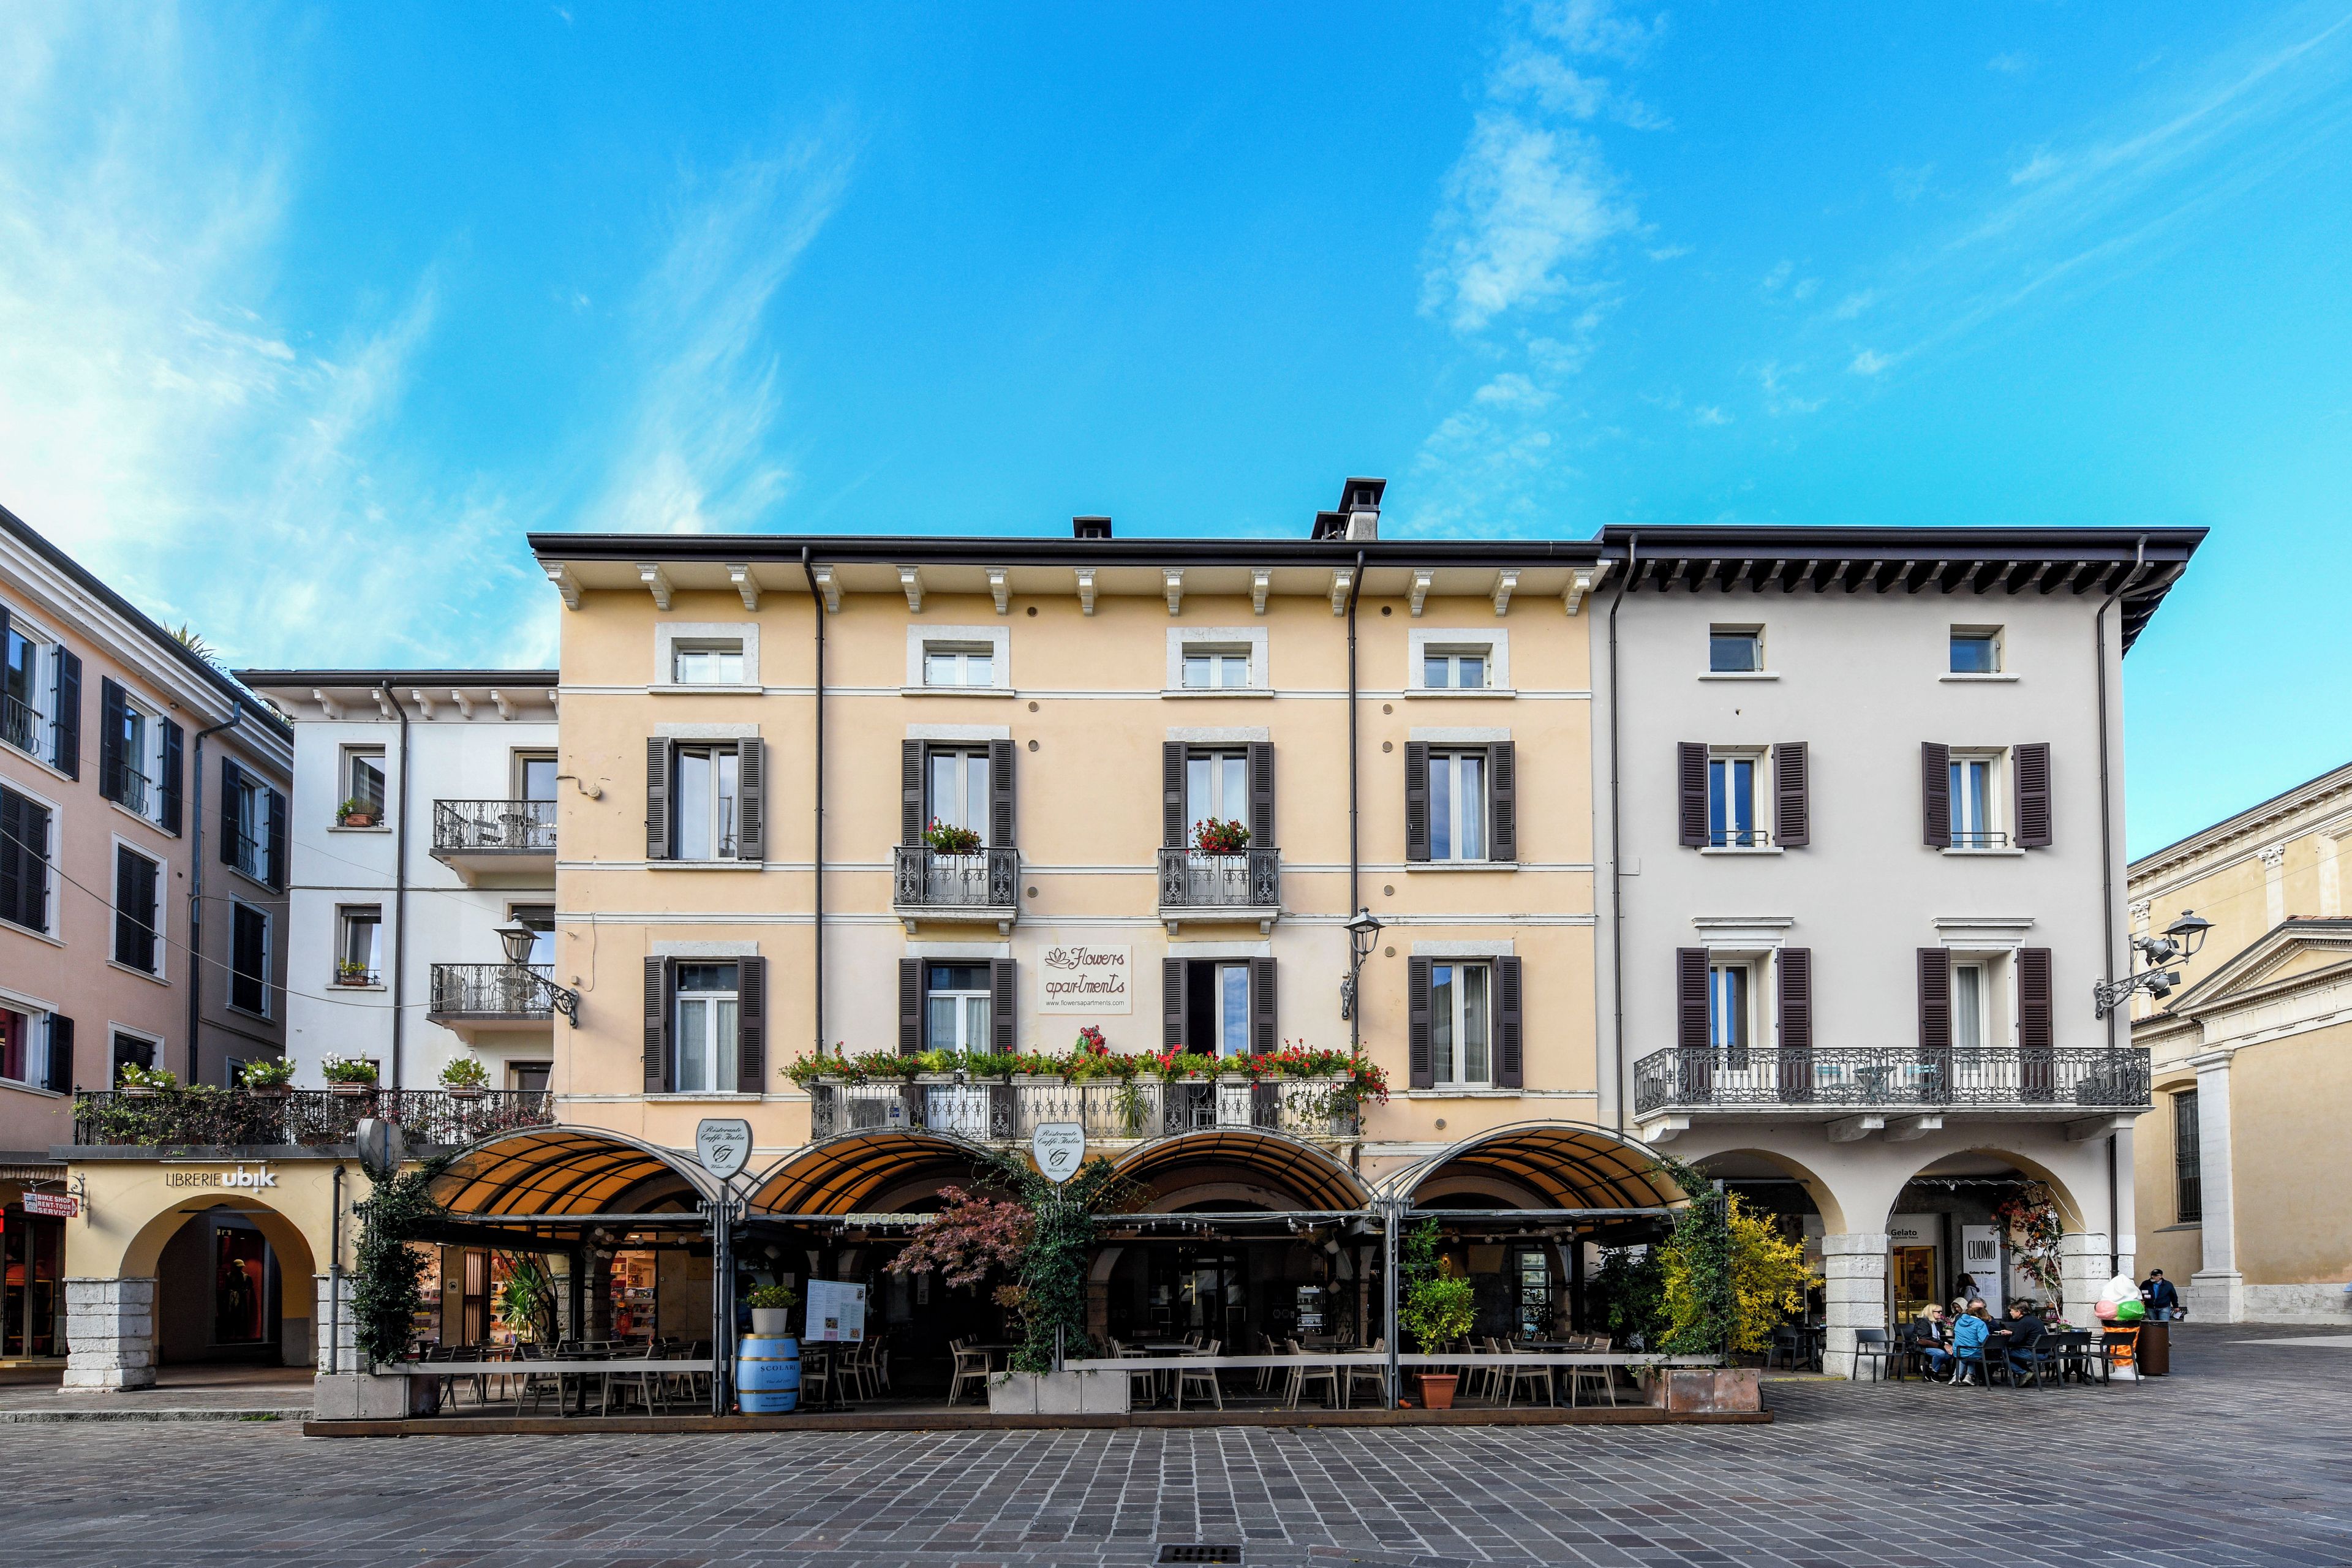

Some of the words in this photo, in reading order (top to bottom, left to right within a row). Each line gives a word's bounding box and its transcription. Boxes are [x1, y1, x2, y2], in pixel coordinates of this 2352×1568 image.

[1068, 947, 1125, 970] Flowers
[1046, 973, 1125, 1000] apartments
[166, 1173, 221, 1186] LIBRERIE
[222, 1166, 276, 1193] ubik
[38, 1207, 71, 1216] SERVICE
[846, 1213, 936, 1224] RISTORANT
[1968, 1240, 1996, 1259] CUOMO
